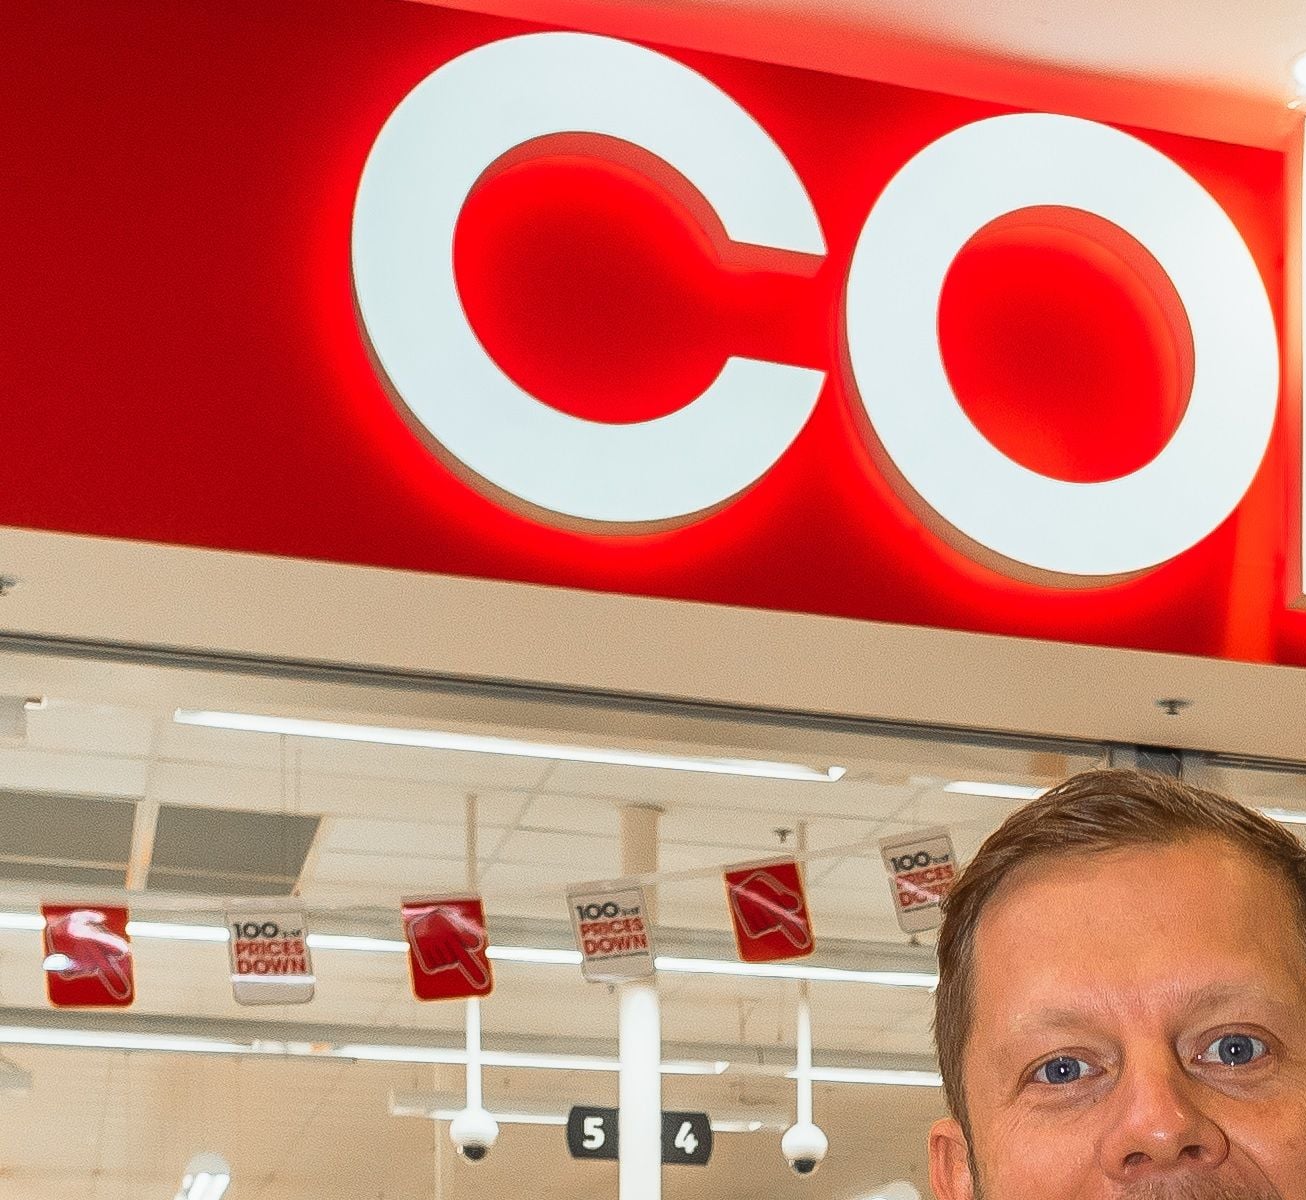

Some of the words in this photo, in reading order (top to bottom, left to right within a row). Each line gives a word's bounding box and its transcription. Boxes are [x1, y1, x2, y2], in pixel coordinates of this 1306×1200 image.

[891, 851, 930, 873] 100
[576, 901, 620, 920] 100
[233, 921, 279, 939] 100
[581, 916, 645, 936] PRICES
[235, 941, 305, 955] PRICES
[584, 934, 649, 955] DOWN
[237, 958, 307, 975] DOWN
[582, 1117, 606, 1149] 5
[674, 1121, 699, 1155] 4
